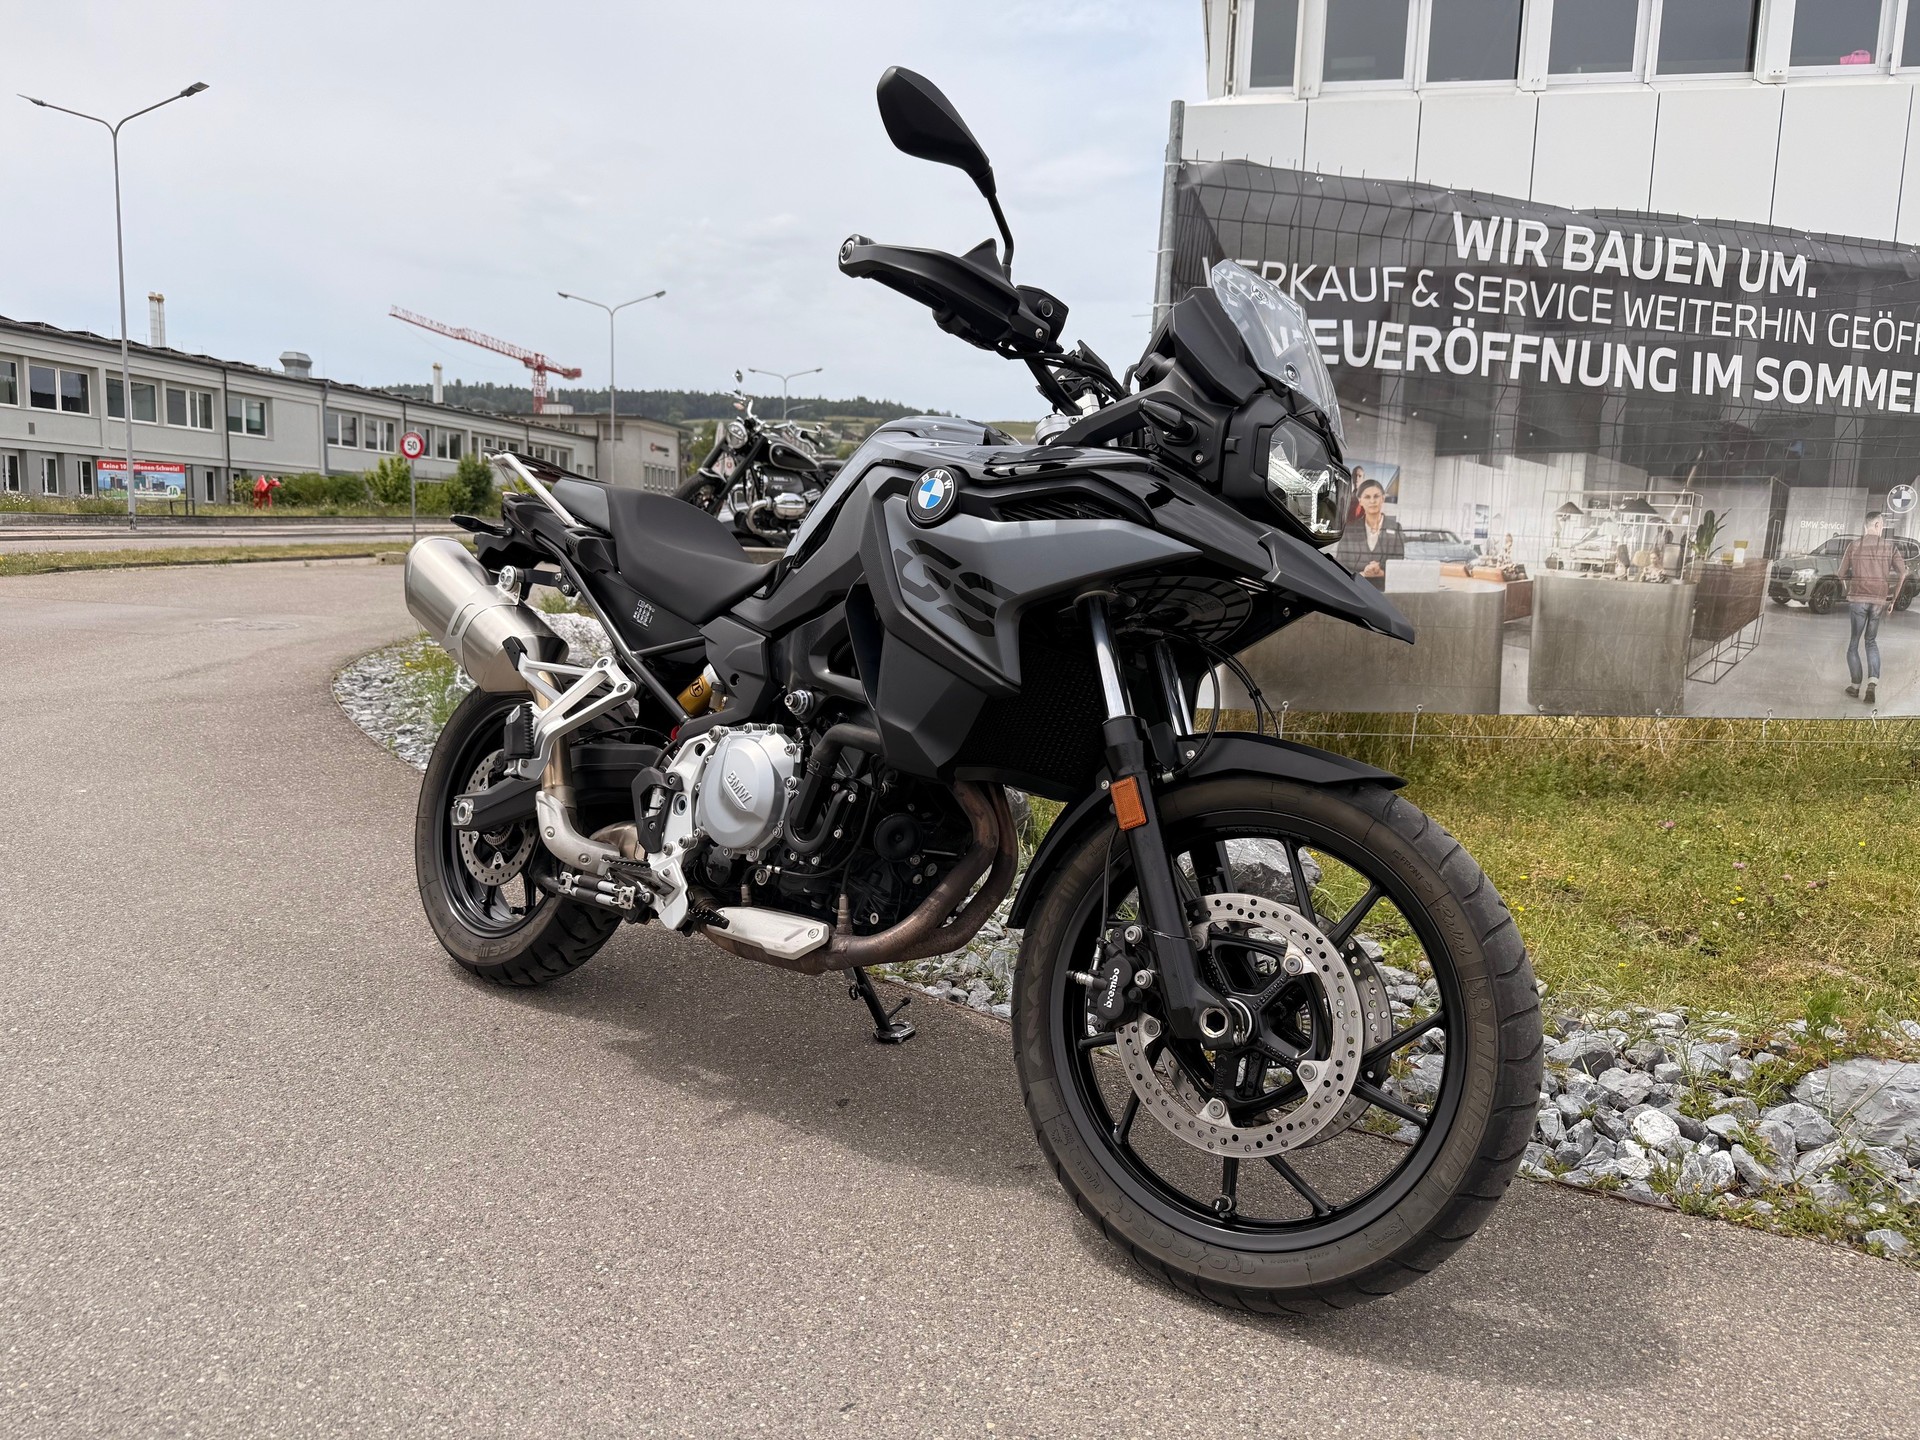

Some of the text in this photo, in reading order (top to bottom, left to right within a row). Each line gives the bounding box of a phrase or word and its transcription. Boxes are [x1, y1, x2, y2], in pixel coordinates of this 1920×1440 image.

[1453, 211, 1817, 298] WIR BAUEN UM.
[1202, 256, 1407, 303] RKAUF
[1411, 268, 1440, 308] &
[1452, 272, 1614, 325] SERVICE
[1623, 290, 1816, 345] WEITERHIN
[1691, 351, 1743, 398] IM
[1753, 356, 1920, 414] SOMME
[407, 441, 418, 451] 50
[102, 462, 119, 470] Keine
[922, 469, 953, 491] BMW
[168, 487, 179, 496] JA
[1800, 520, 1846, 530] BMW Service
[727, 769, 753, 805] BMW
[1400, 855, 1425, 882] FRONT
[1103, 967, 1120, 1009] brembo
[1436, 1021, 1497, 1193] MICHELIN
